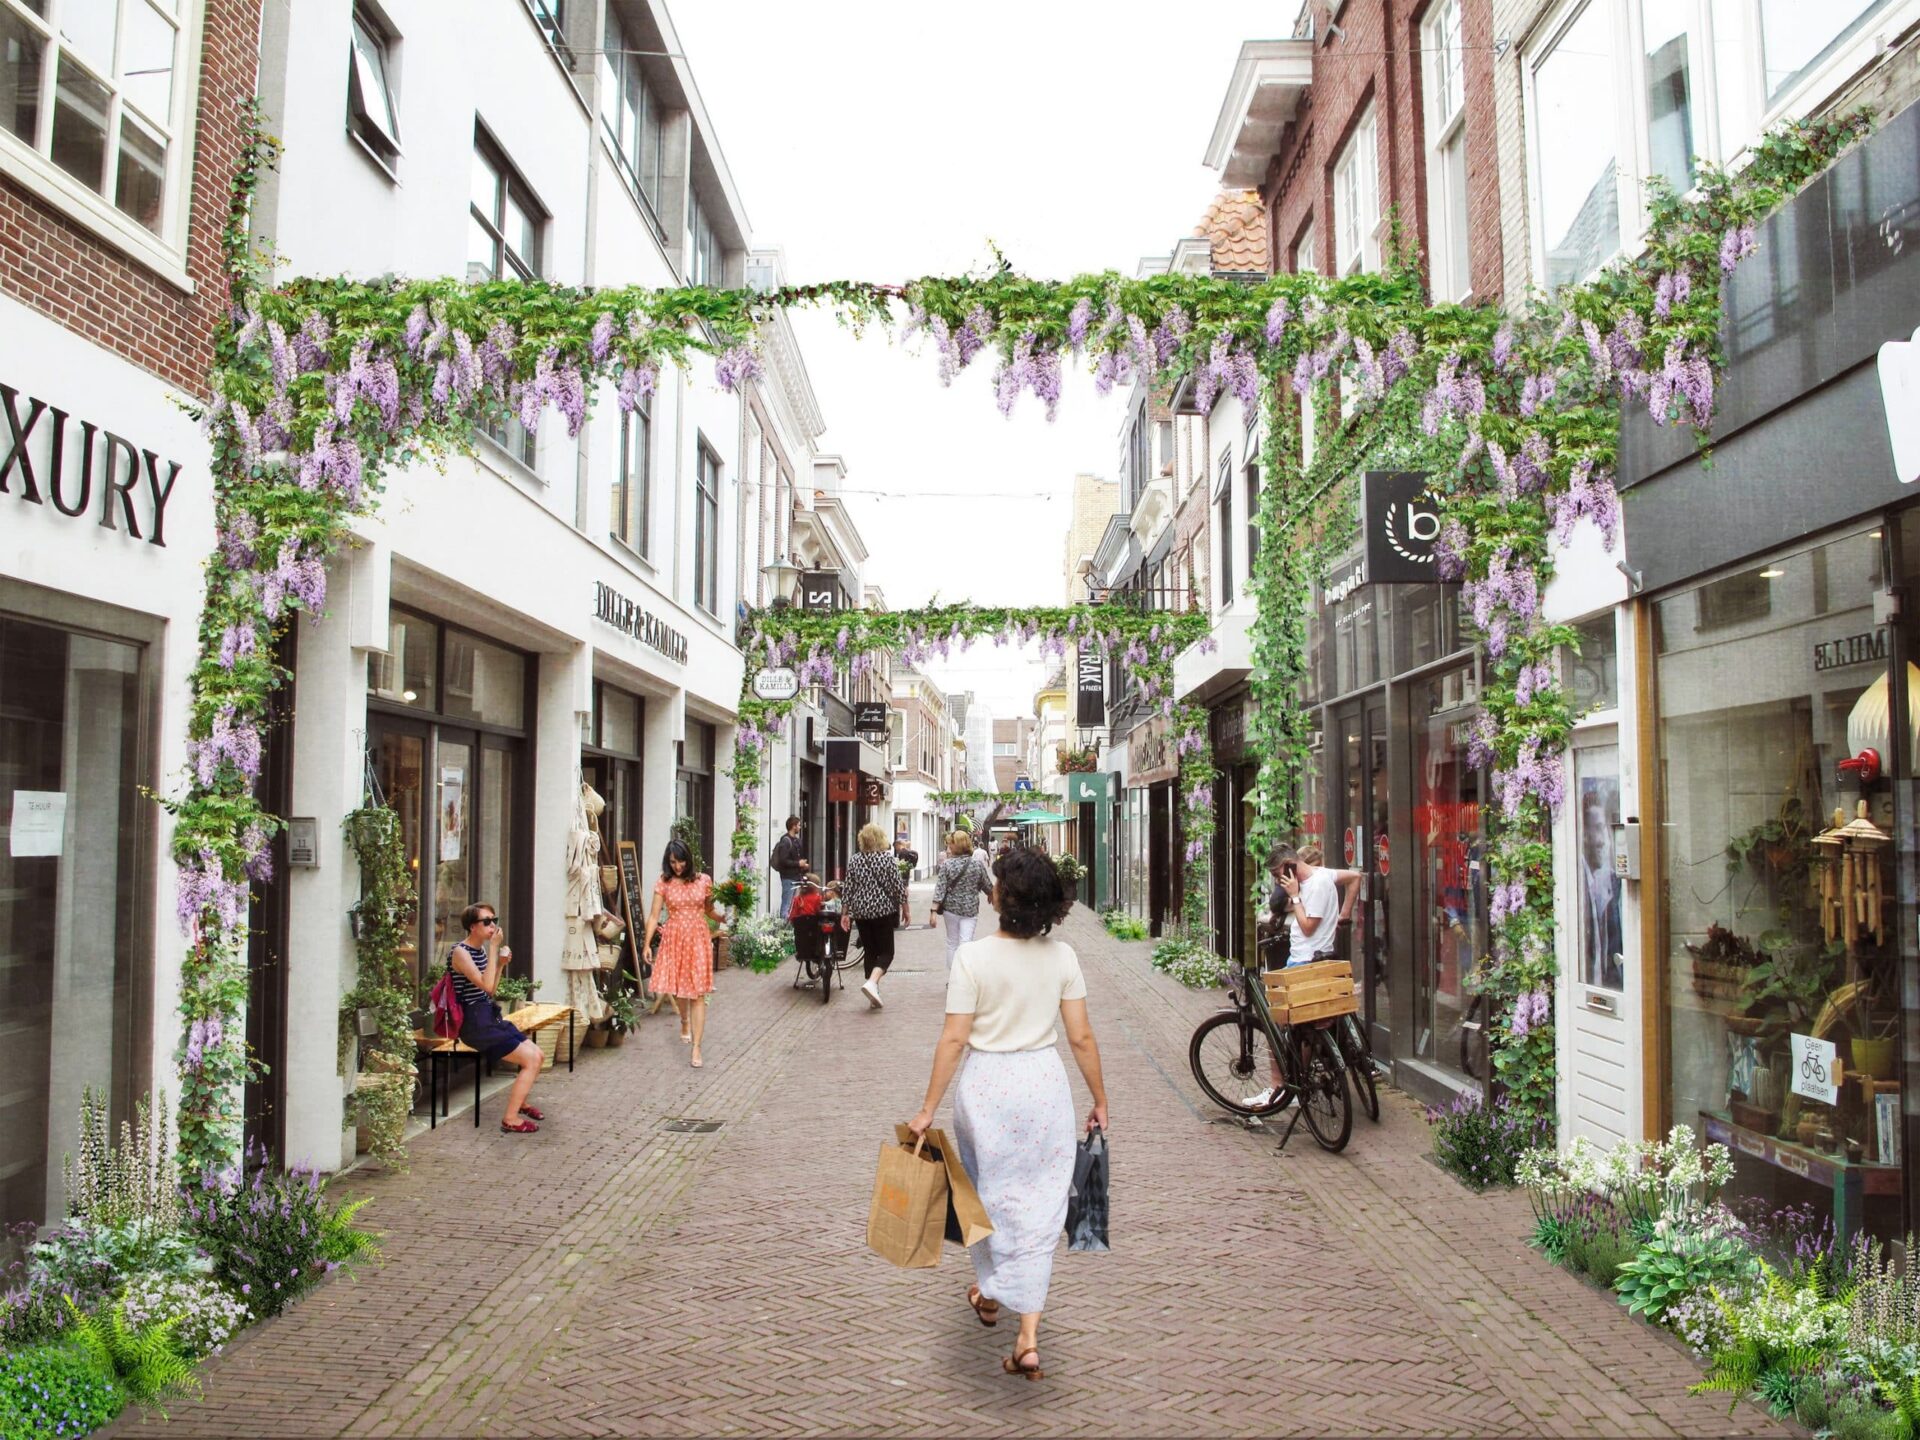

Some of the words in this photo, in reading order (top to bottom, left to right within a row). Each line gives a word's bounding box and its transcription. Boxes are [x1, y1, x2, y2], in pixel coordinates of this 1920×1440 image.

[596, 580, 634, 636] DILLE
[634, 605, 646, 643] &
[645, 611, 688, 667] KAMILLE
[1079, 648, 1102, 685] RAK
[1804, 1038, 1823, 1052] Geen
[1801, 1081, 1829, 1097] plaatsen
